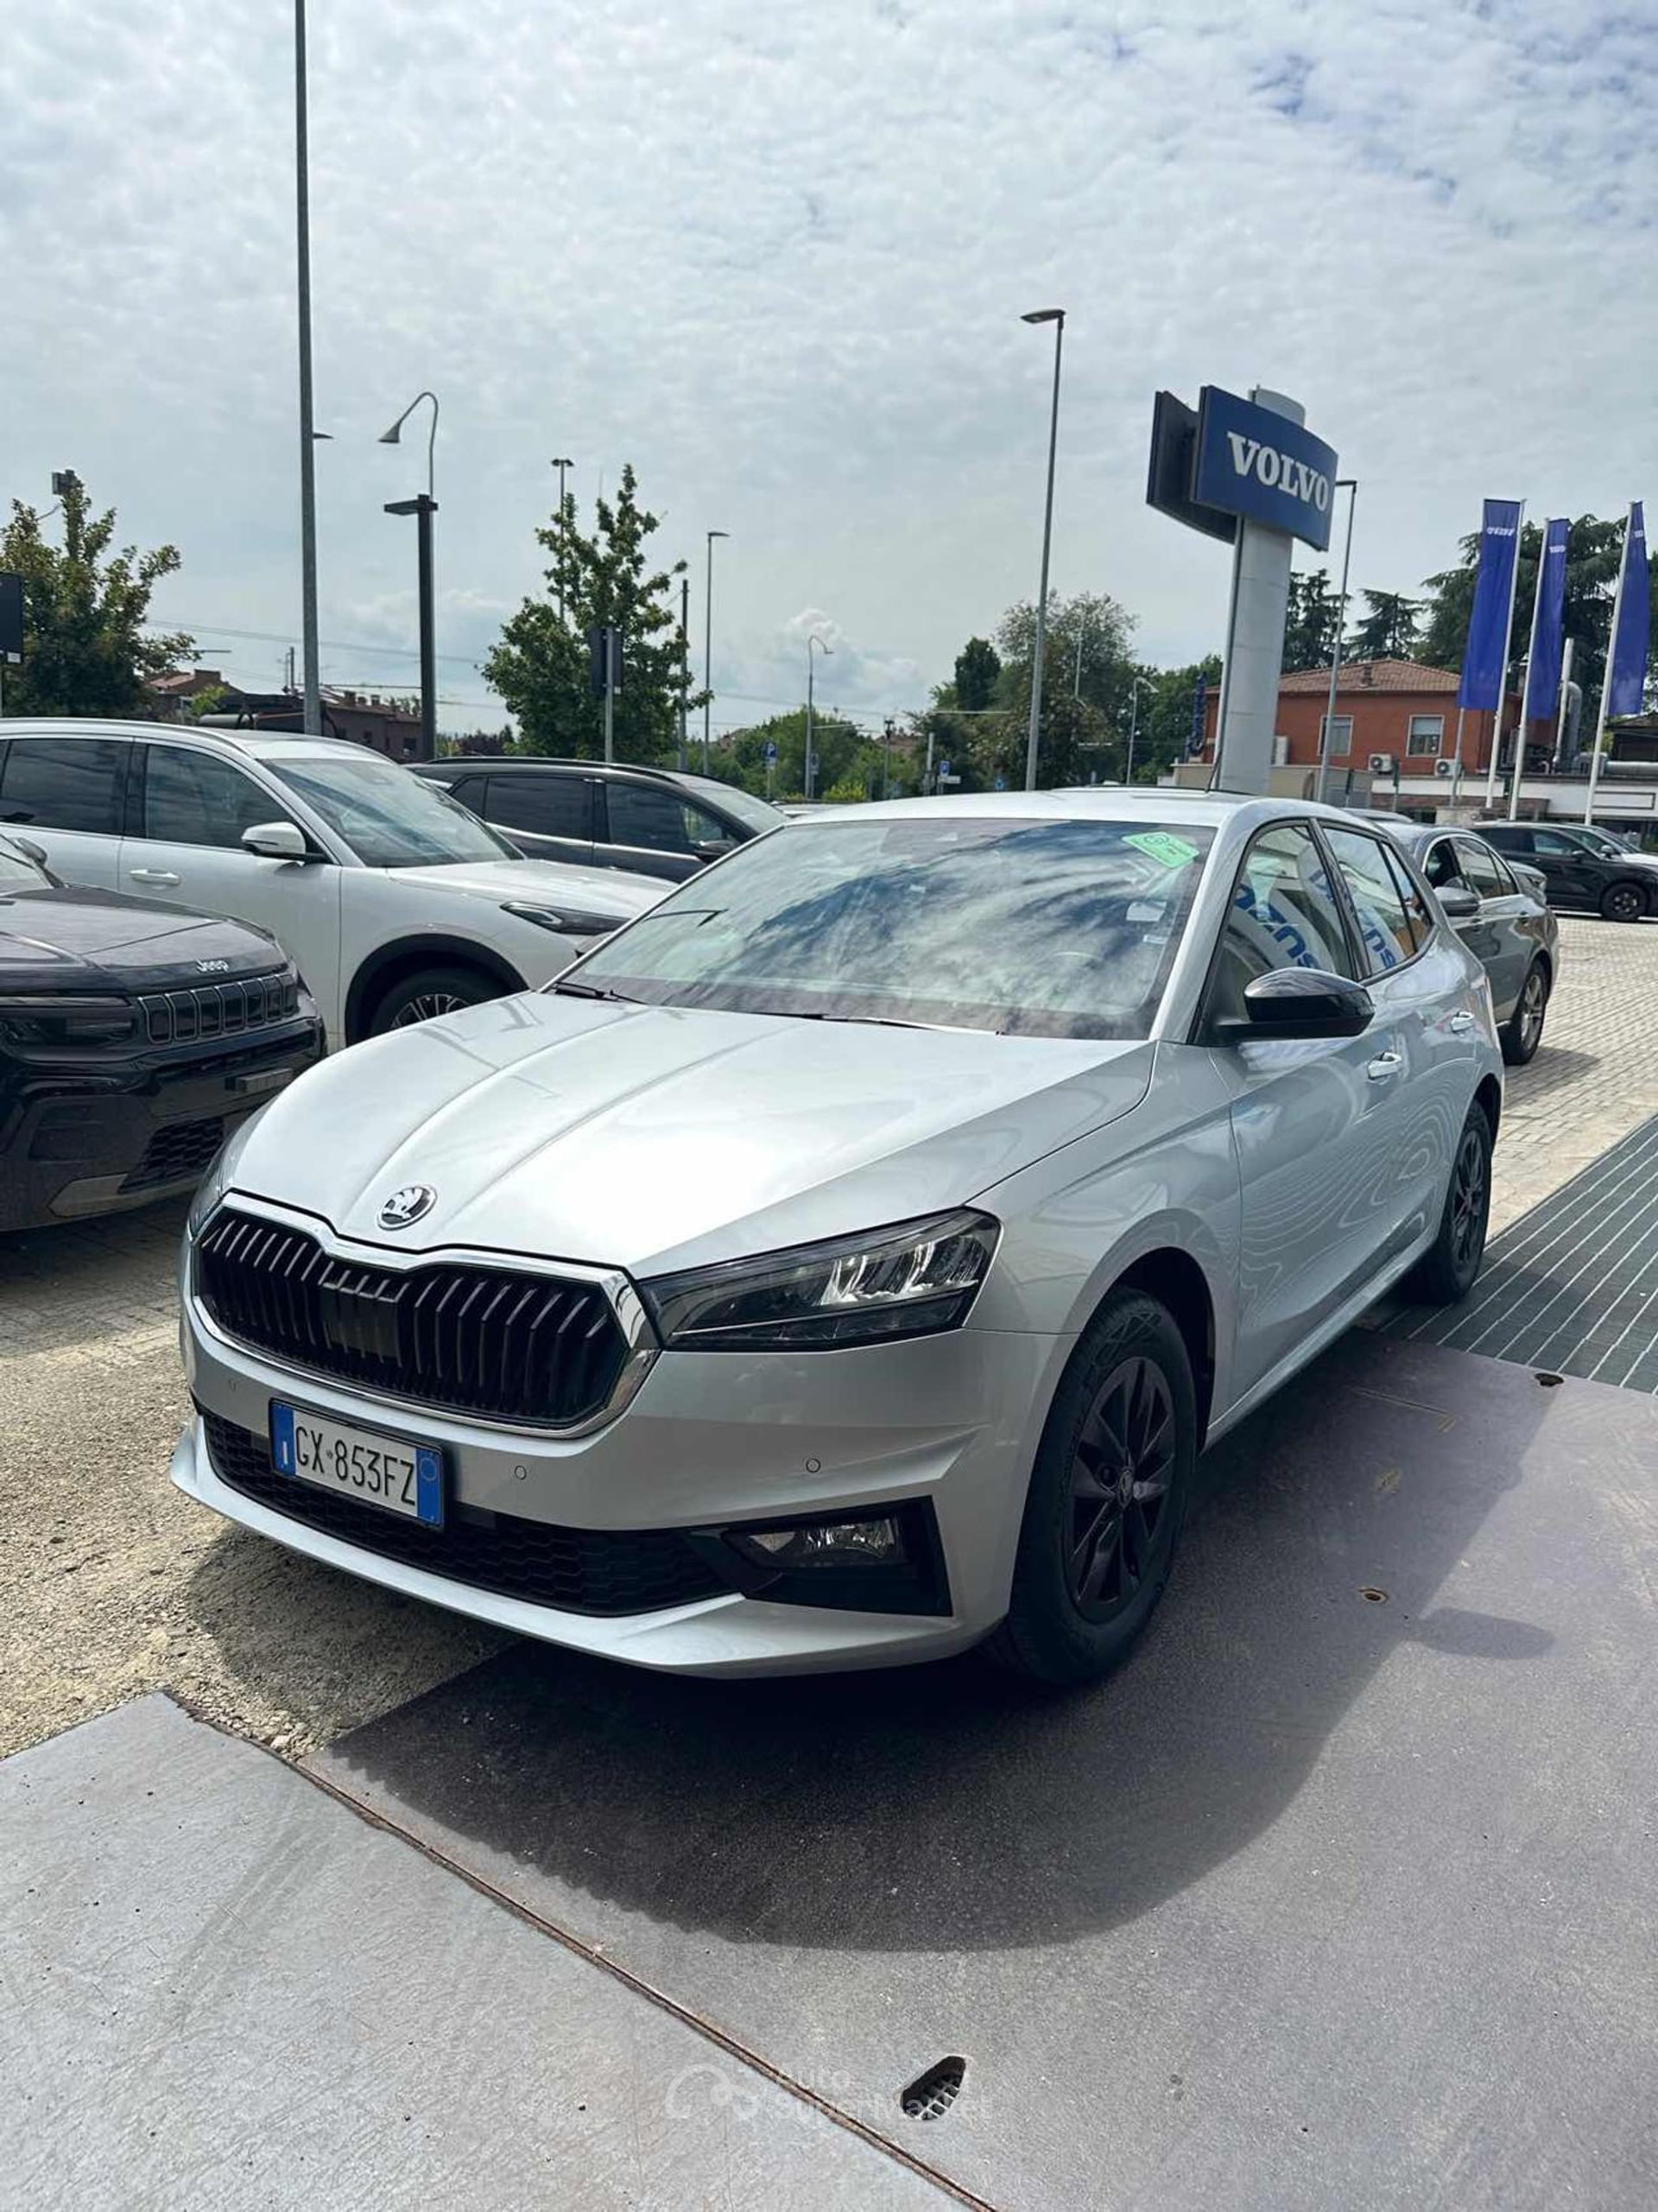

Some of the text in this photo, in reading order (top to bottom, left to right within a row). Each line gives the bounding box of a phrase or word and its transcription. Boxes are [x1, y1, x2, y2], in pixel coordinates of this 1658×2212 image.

[1227, 431, 1328, 511] VOLVO
[196, 959, 229, 973] Jeep
[334, 1439, 415, 1506] 853FZ
